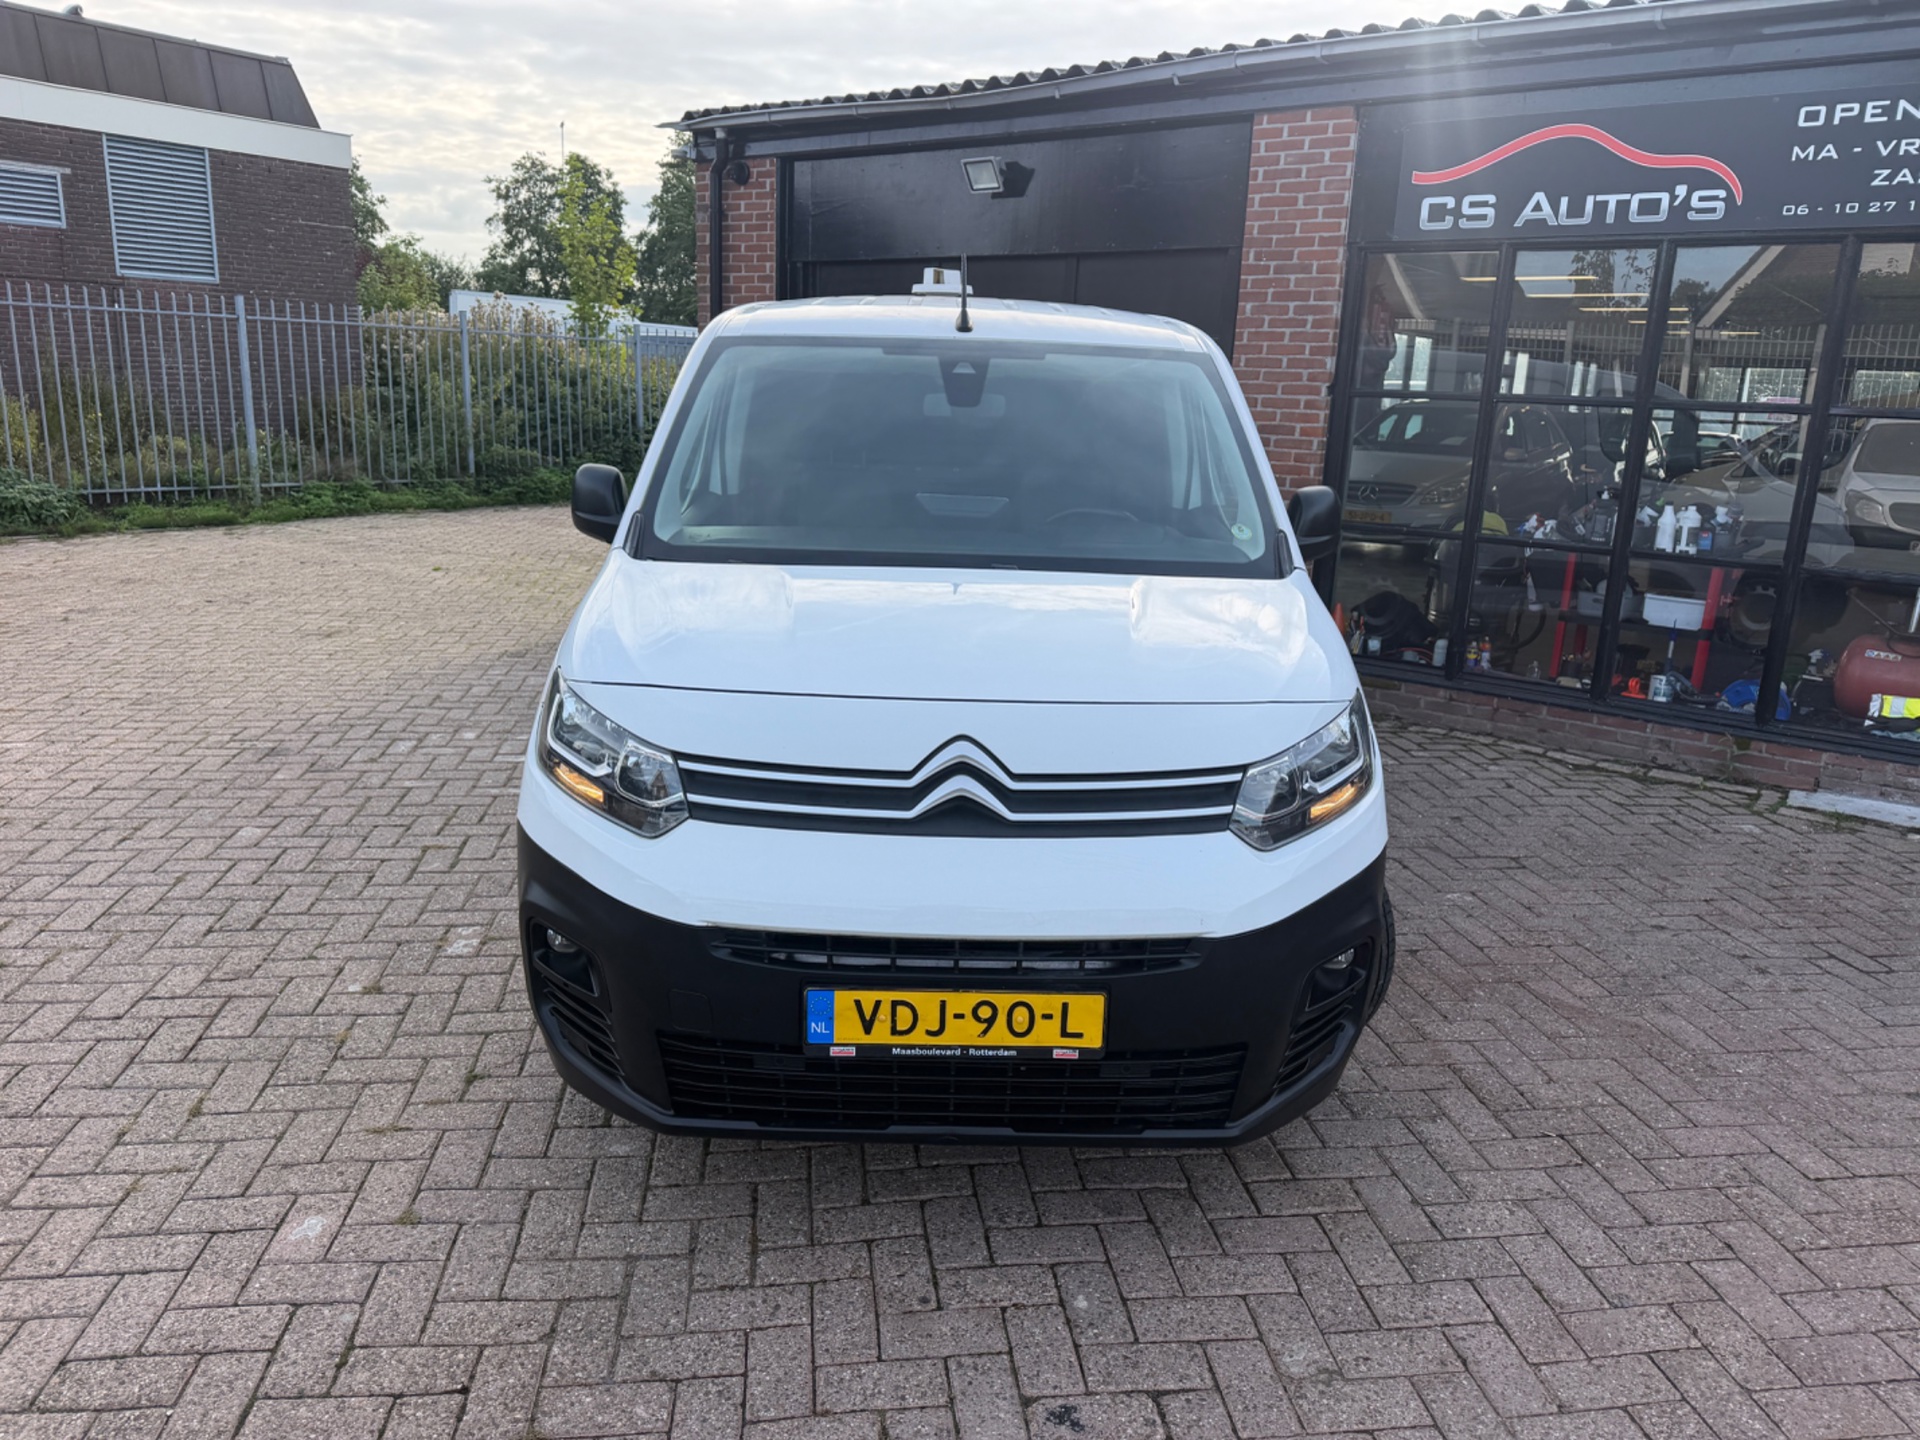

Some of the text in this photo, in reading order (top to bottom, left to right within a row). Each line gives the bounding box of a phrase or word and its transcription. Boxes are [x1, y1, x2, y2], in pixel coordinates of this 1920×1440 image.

[1791, 143, 1838, 162] MA
[1876, 138, 1920, 157] VR
[1870, 167, 1920, 186] ZA
[1419, 194, 1497, 231] CS
[1782, 204, 1809, 216] 06
[1834, 202, 1859, 214] 10
[1867, 201, 1897, 213] 27
[810, 1021, 830, 1034] NL
[853, 999, 1084, 1039] VDJ-90-L
[892, 1047, 961, 1056] Maasboulevard
[969, 1048, 1017, 1057] Rotterdam
